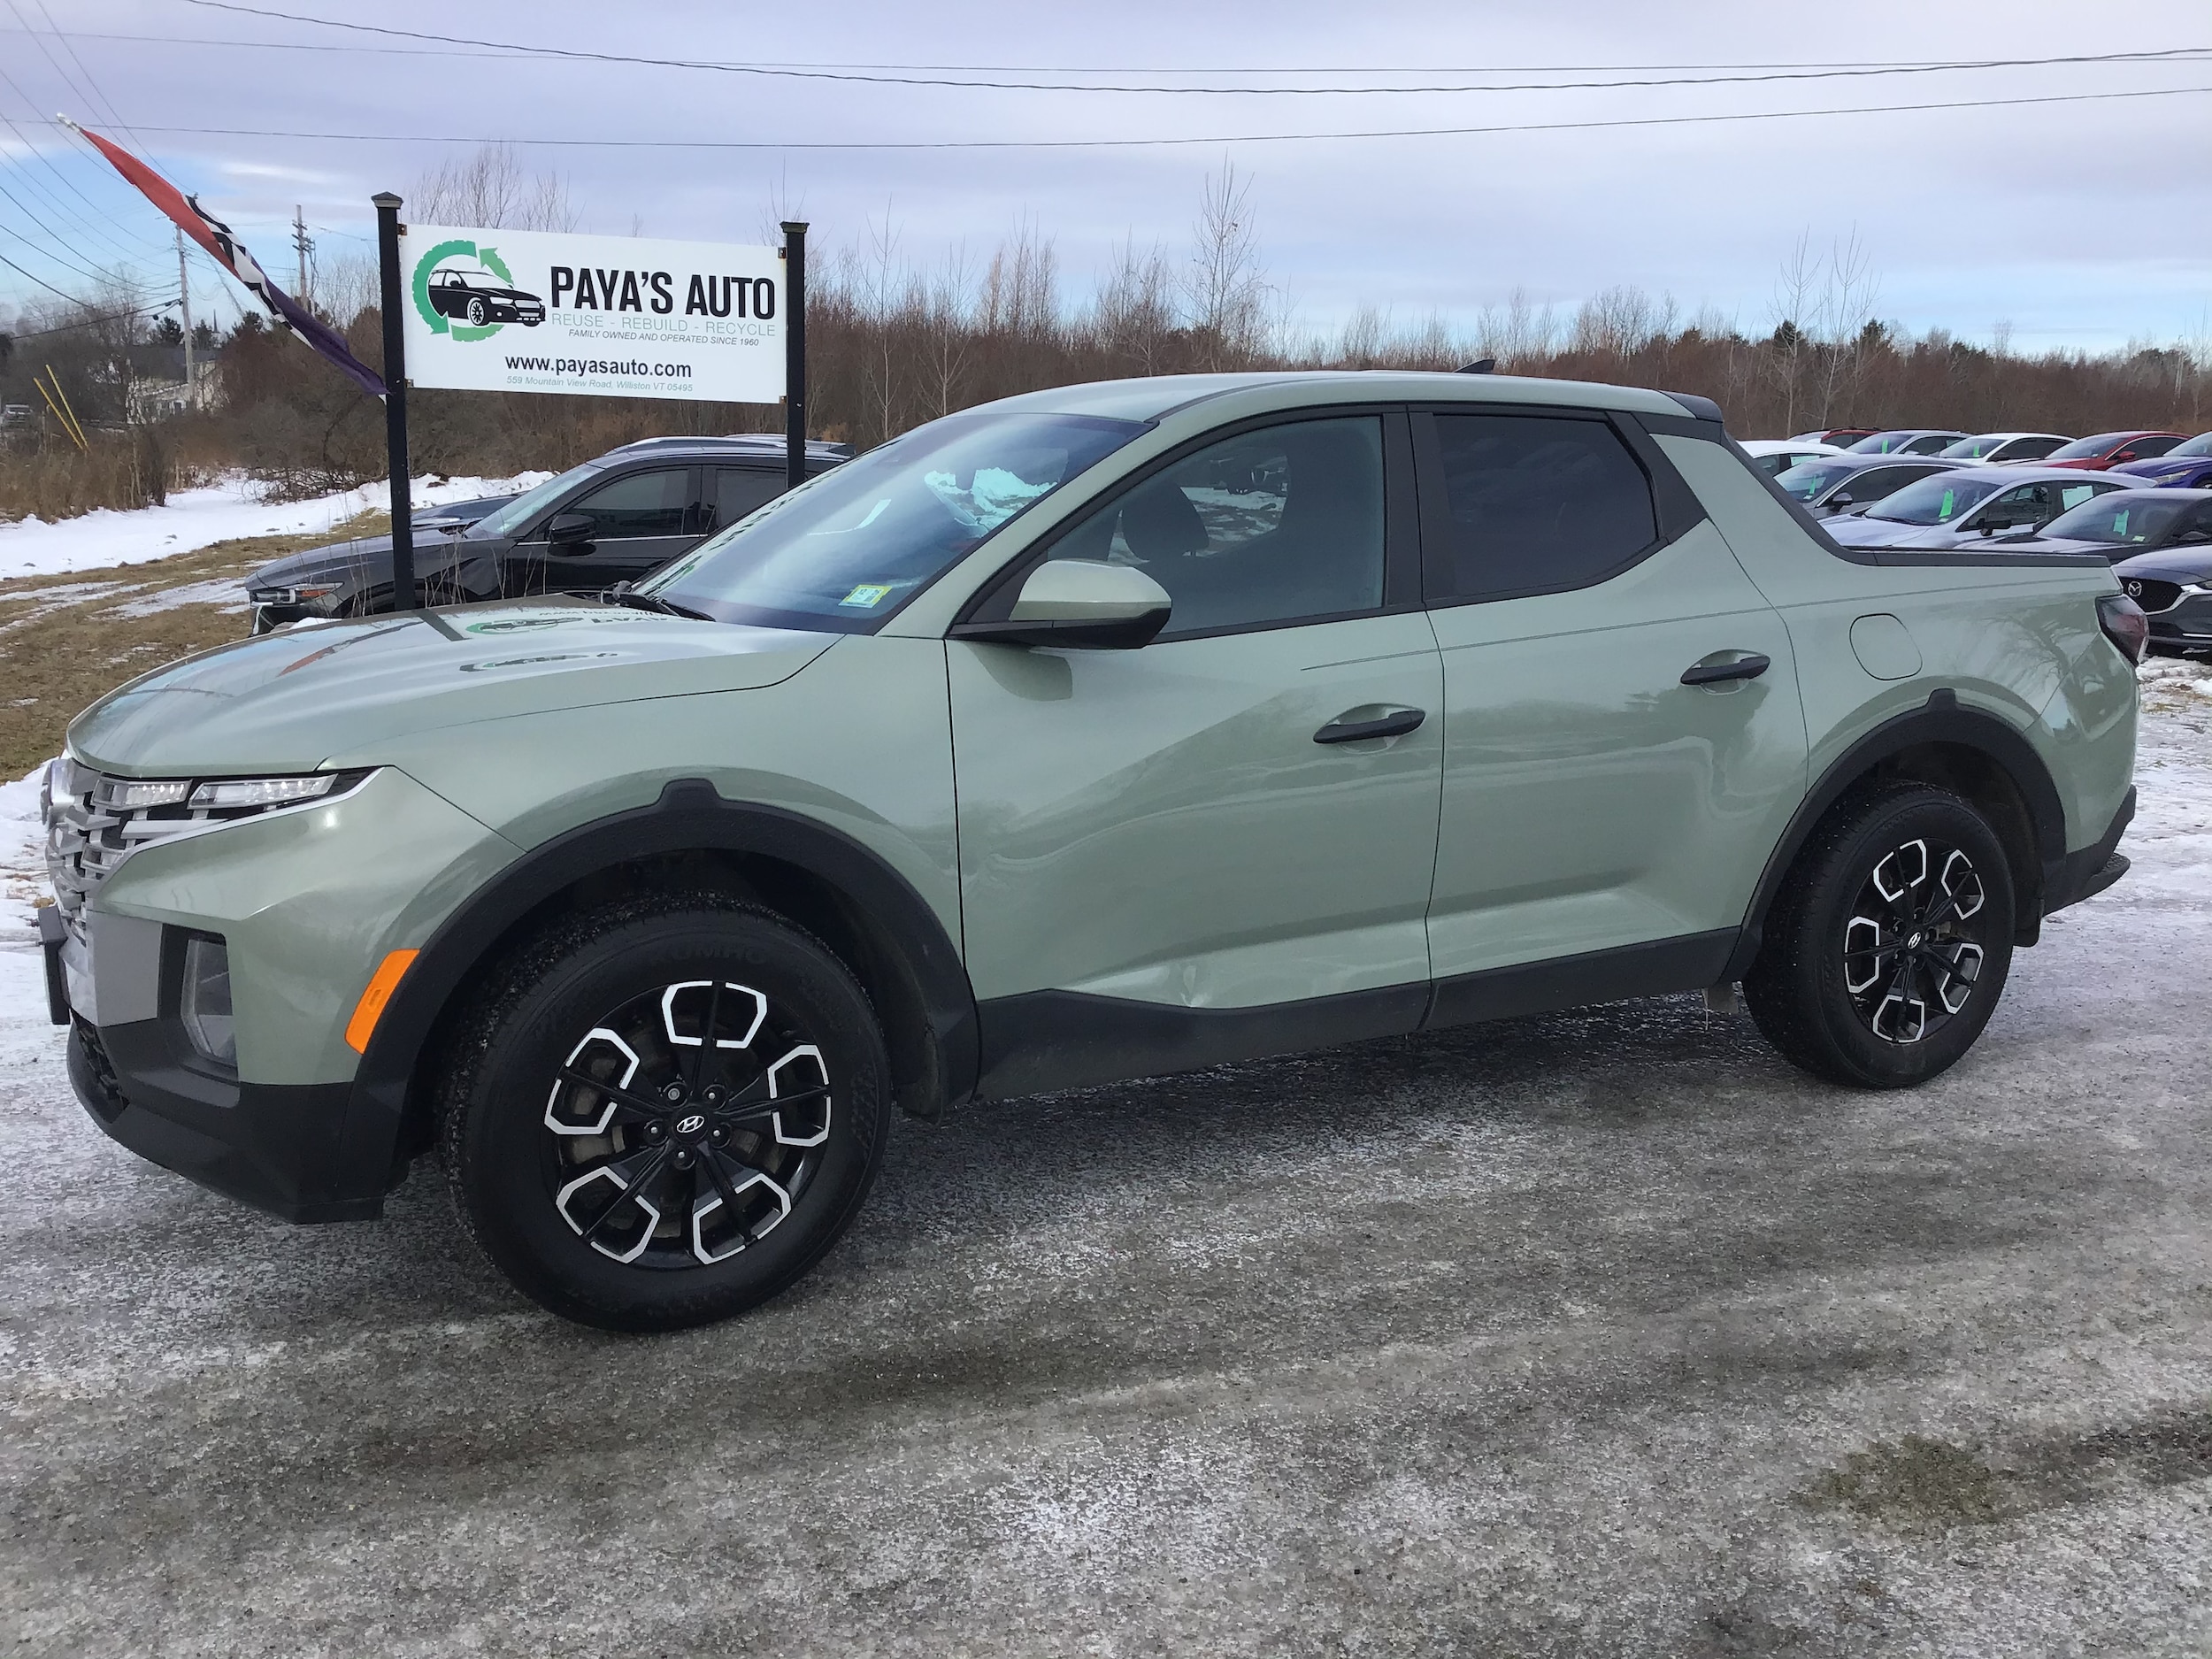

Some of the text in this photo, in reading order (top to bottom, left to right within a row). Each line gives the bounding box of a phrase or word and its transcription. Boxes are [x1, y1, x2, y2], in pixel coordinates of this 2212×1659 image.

[550, 265, 775, 319] PAYA'S AUTO
[551, 313, 603, 327] REUSE
[622, 317, 688, 332] REBUILD
[706, 321, 776, 337] RECYCLE
[568, 328, 759, 347] FAMILY OWNED AND OPERATED SINCE 1960
[505, 356, 692, 378] www.payasauto.com
[506, 375, 523, 384] 559
[525, 376, 565, 387] Mountain
[566, 378, 588, 387] View
[588, 380, 613, 389] Road,
[616, 380, 651, 390] Williston
[666, 383, 693, 392] 05495
